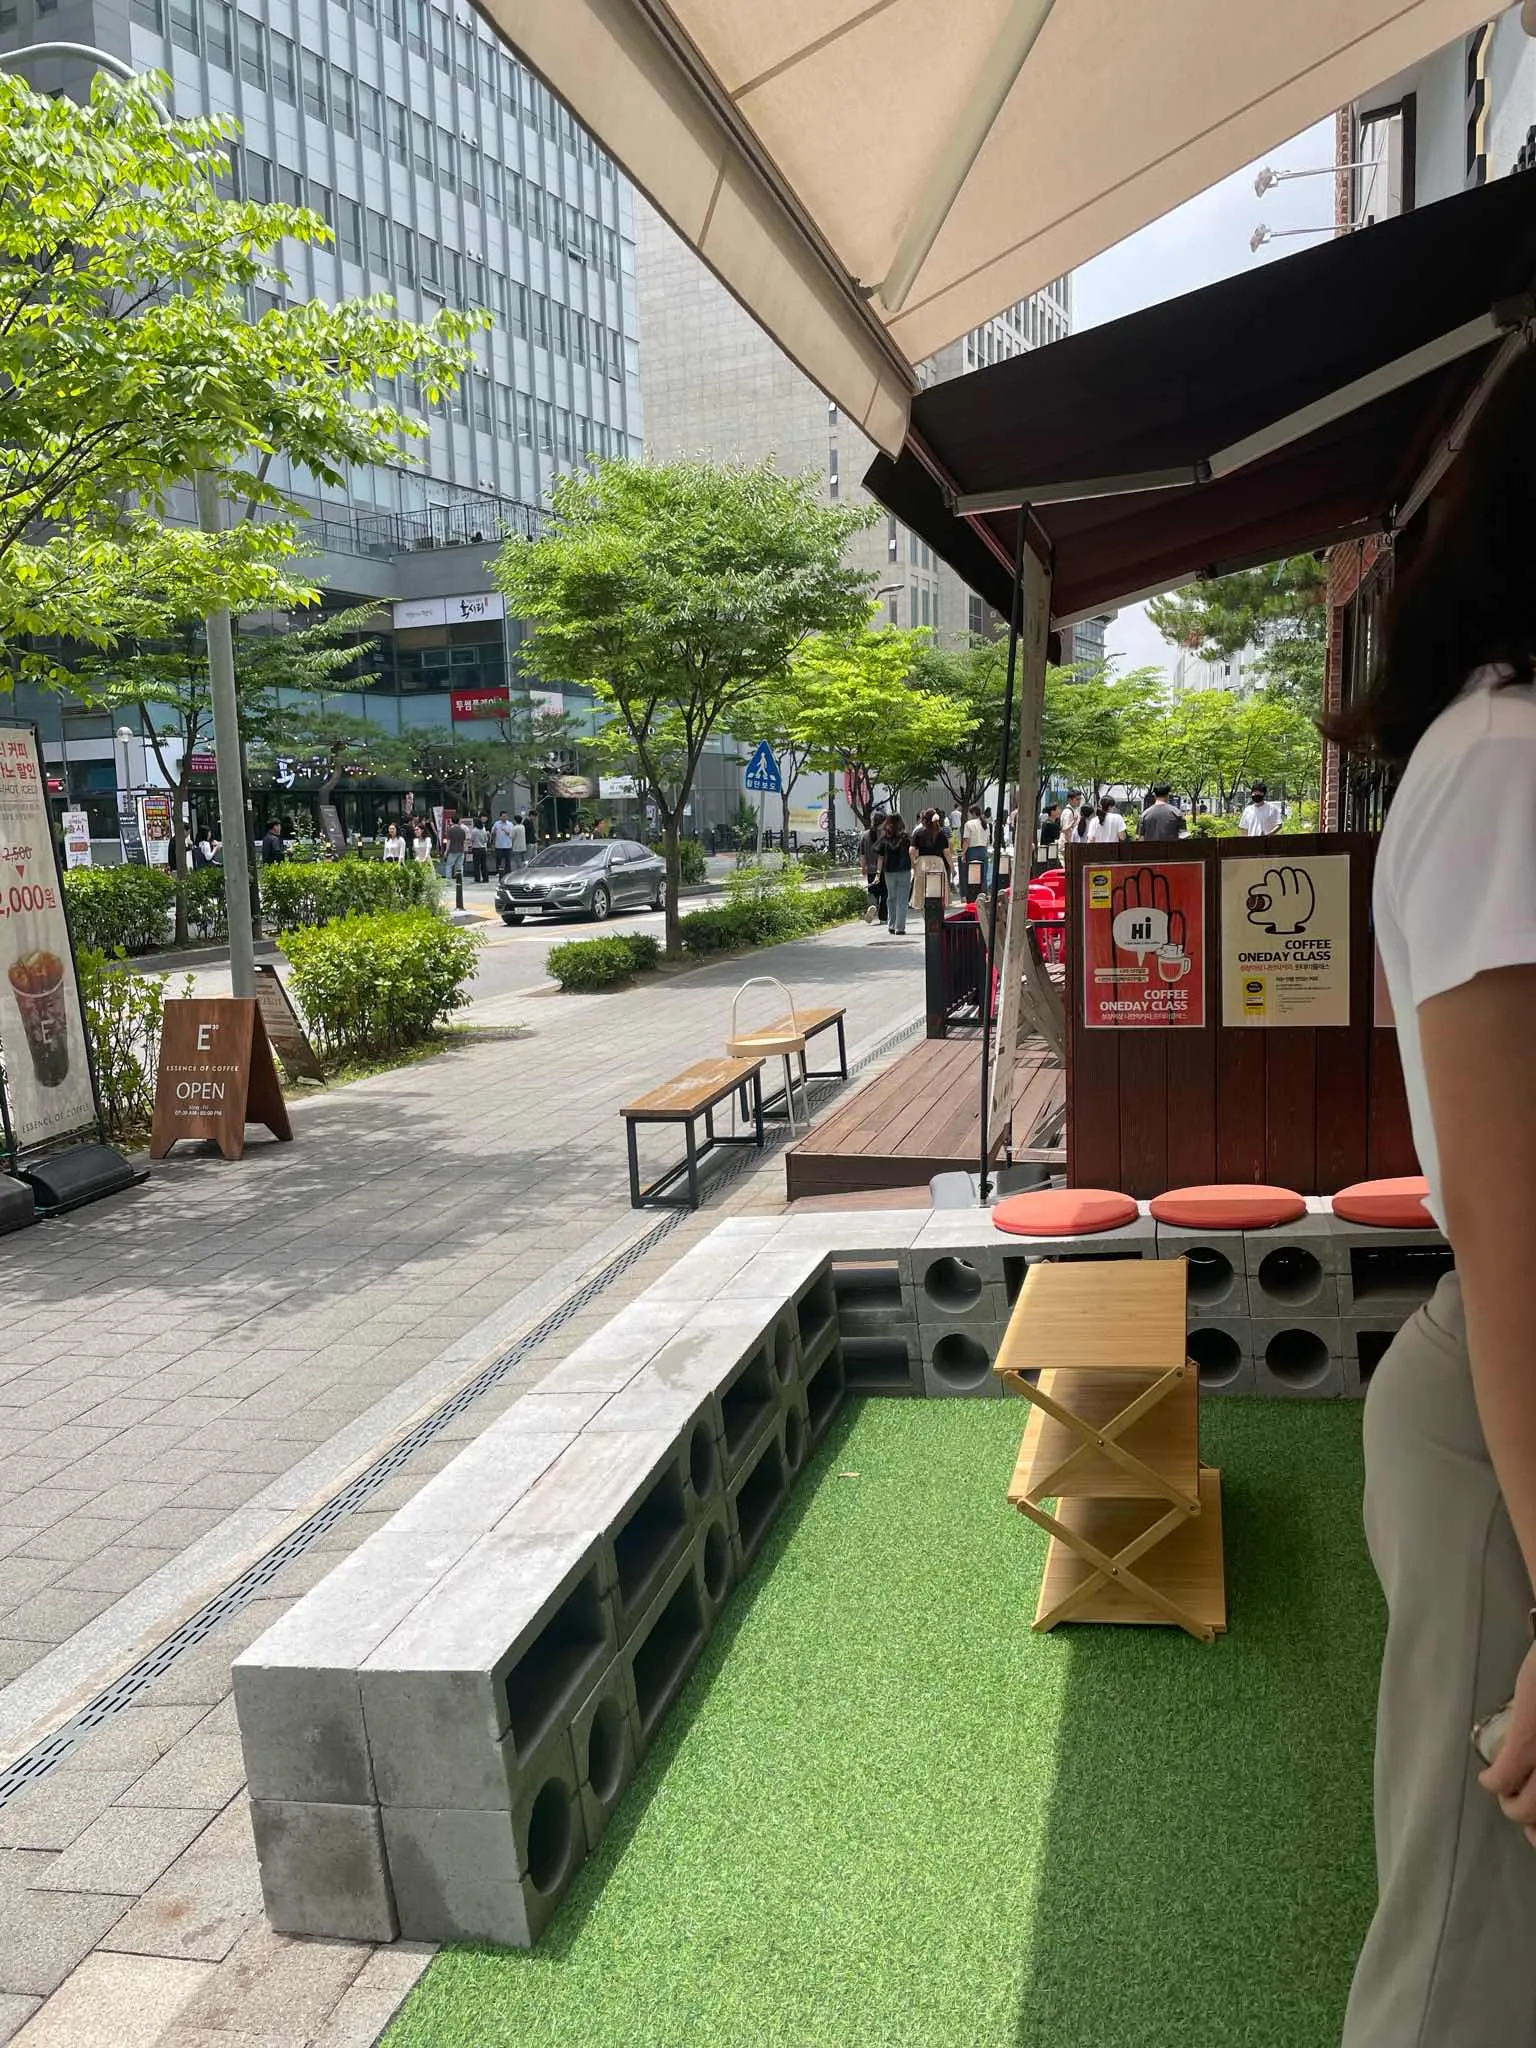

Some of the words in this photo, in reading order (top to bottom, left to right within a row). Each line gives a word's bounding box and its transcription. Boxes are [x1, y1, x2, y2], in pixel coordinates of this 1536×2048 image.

[8, 742, 28, 759] 커피
[16, 762, 37, 779] 할인
[3, 846, 32, 862] 2,500
[1131, 916, 1152, 940] Hi
[1285, 939, 1332, 950] COFFEE
[1238, 951, 1290, 962] ONEDAY
[1292, 951, 1332, 961] CLASS
[1143, 989, 1189, 1000] COFFEE
[1100, 1001, 1149, 1011] ONEDAY
[1151, 1001, 1189, 1011] CLASS
[176, 1081, 225, 1100] OPEN
[22, 1115, 52, 1134] ESSENCE
